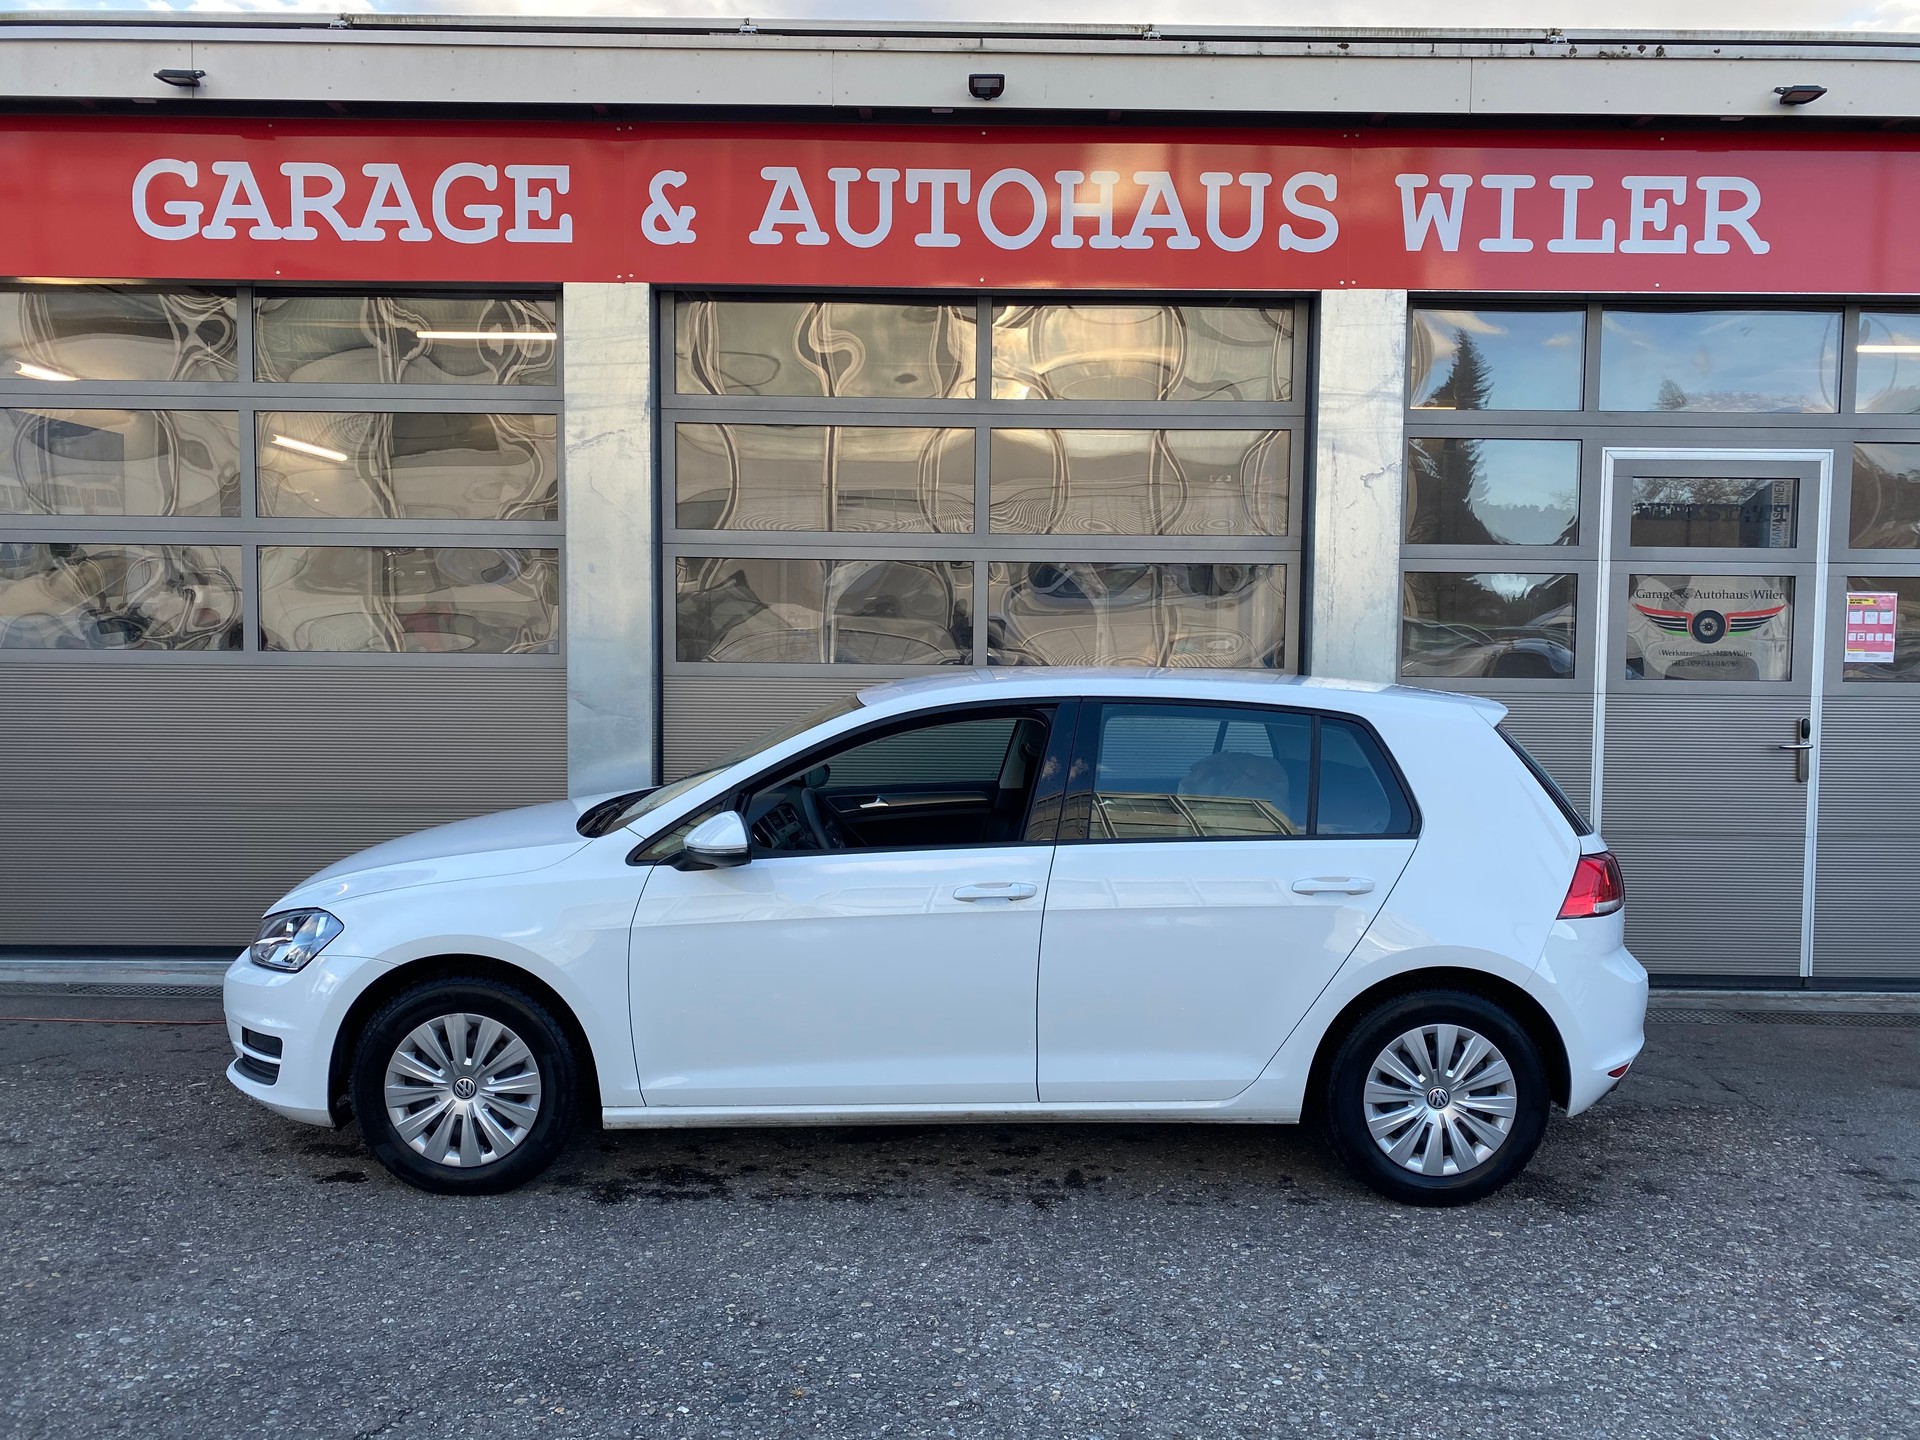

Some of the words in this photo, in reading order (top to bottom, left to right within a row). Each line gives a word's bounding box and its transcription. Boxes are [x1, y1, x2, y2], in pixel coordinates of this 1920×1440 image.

[132, 158, 573, 245] GARAGE
[641, 169, 697, 246] &
[748, 166, 1340, 253] AUTOHAUS
[1394, 173, 1771, 255] WILER
[1636, 588, 1676, 601] Garage
[1679, 590, 1690, 599] &
[1693, 589, 1749, 600] Autohaus
[1752, 589, 1785, 600] Wiler
